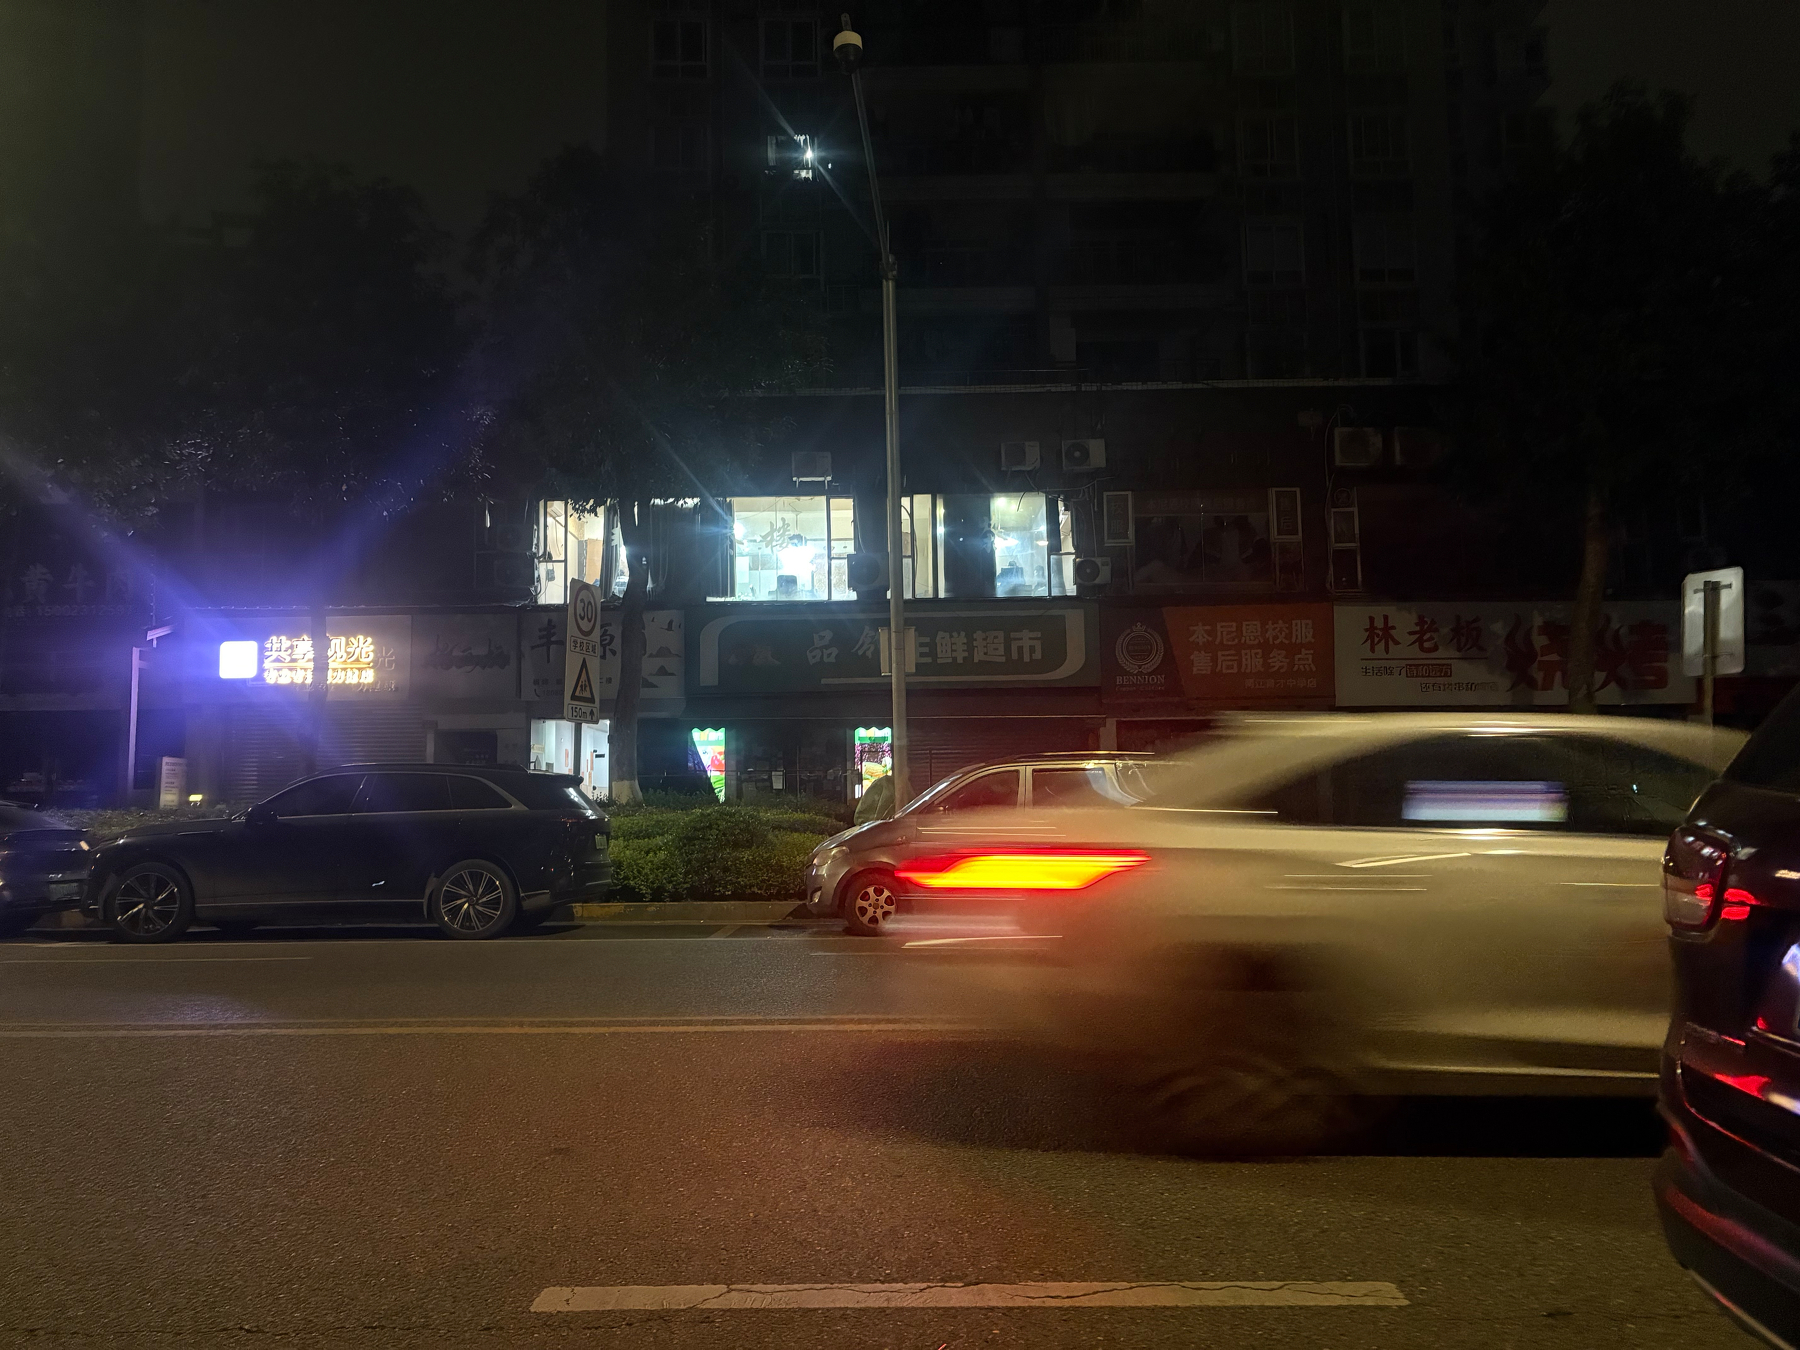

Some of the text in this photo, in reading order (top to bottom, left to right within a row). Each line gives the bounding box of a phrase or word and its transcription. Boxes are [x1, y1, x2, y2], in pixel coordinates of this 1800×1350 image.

[579, 597, 594, 624] 30
[1188, 619, 1315, 646] 本尼恩校服
[1360, 613, 1488, 655] 林老板
[572, 638, 597, 655] 学校区域
[1189, 648, 1317, 675] 售后服务点
[1116, 674, 1165, 685] BENNION
[571, 706, 588, 720] 150m
